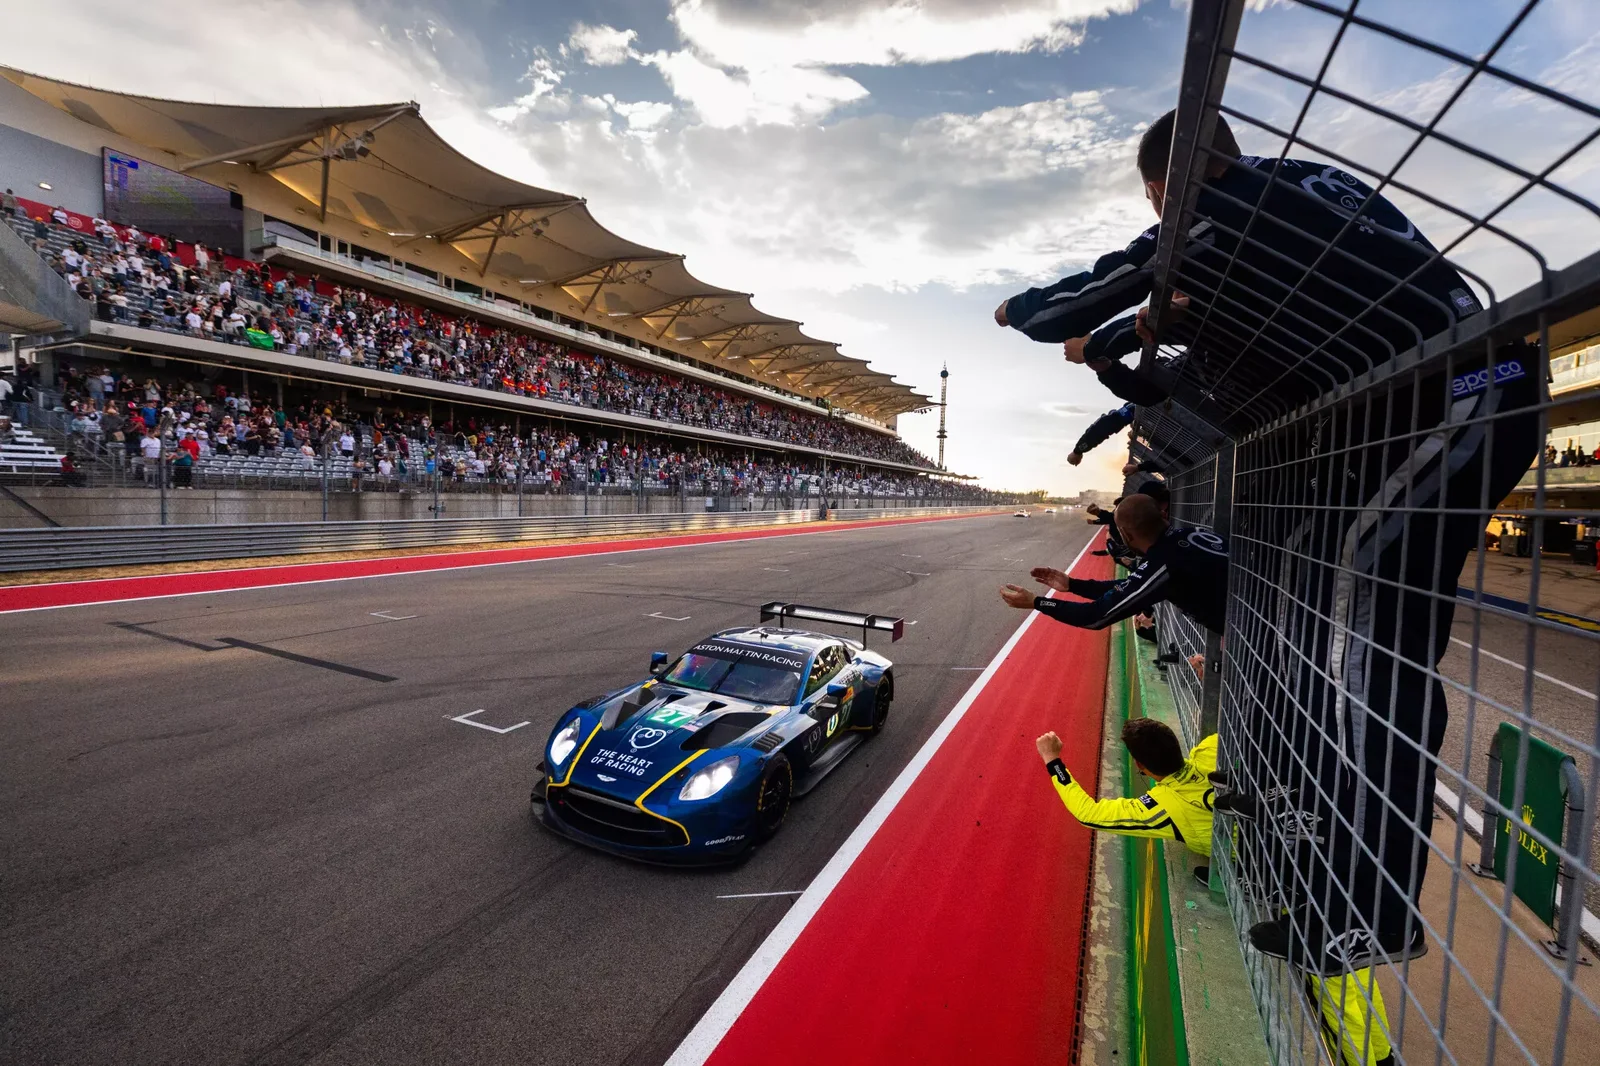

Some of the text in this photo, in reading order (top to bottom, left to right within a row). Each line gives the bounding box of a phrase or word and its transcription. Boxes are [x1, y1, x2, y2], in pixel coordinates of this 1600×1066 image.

[1452, 361, 1521, 392] spaco
[693, 644, 725, 652] ASTON
[763, 653, 803, 668] RACING
[650, 708, 693, 725] 27
[590, 756, 646, 776] OF RACING
[596, 748, 654, 769] THE HEART
[1505, 818, 1547, 865] RLEX
